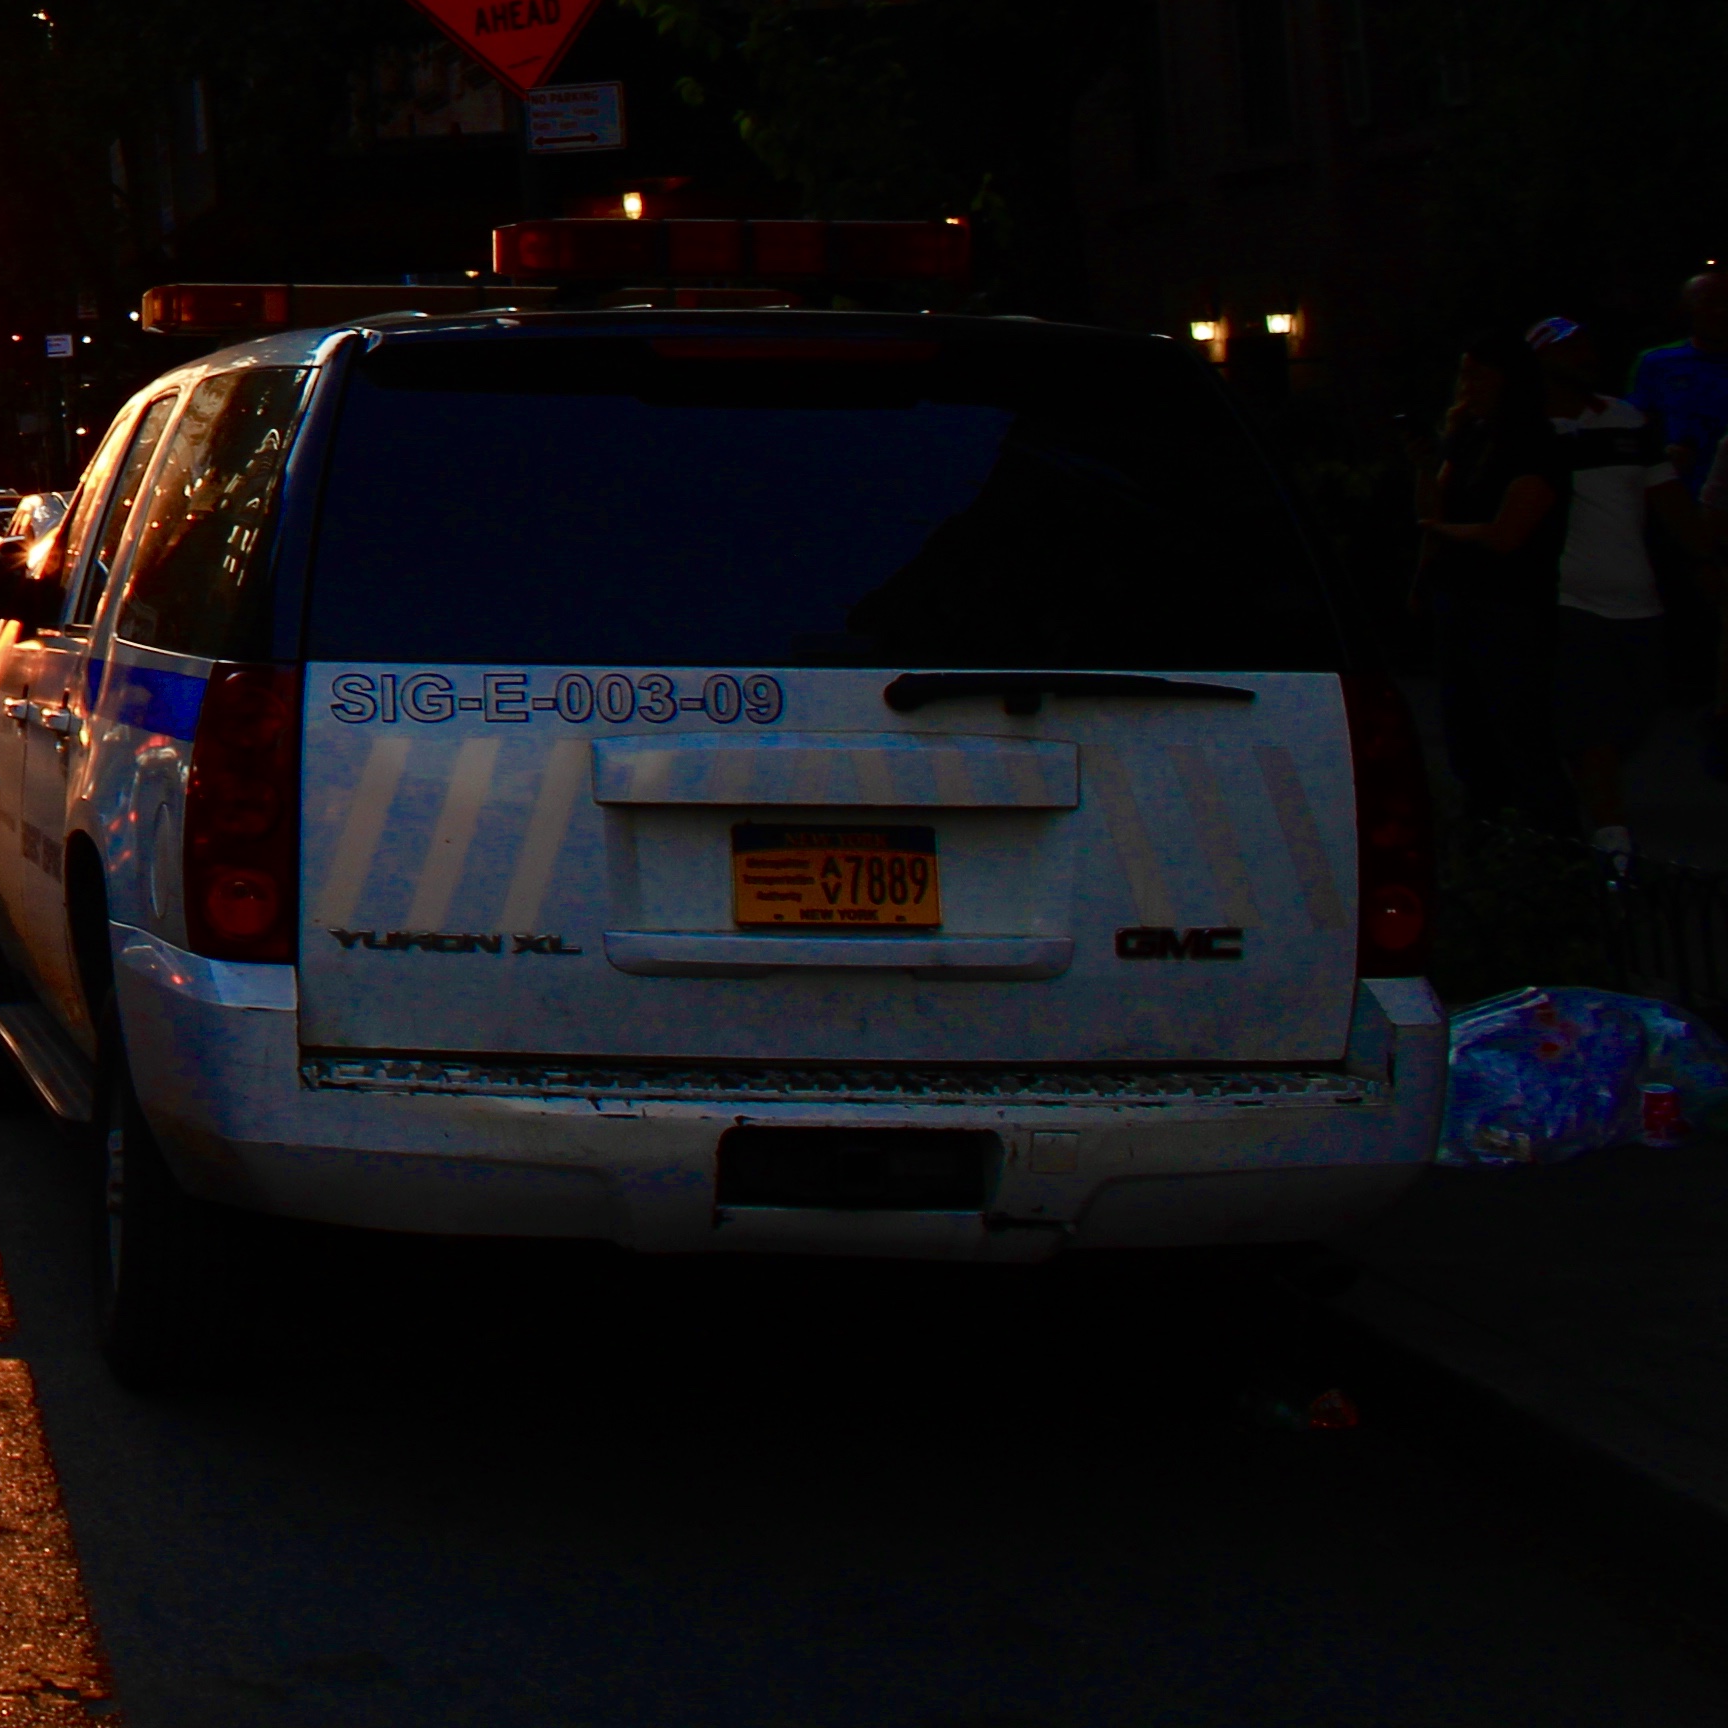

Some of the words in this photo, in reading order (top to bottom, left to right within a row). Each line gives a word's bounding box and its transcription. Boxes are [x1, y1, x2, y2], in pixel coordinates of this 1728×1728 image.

[549, 91, 600, 104] PARKING
[330, 672, 785, 725] SIG-E-003-09
[800, 908, 834, 921] NEW
[837, 908, 878, 921] YORK
[328, 929, 502, 954] YUKON
[512, 934, 583, 955] XL
[1115, 926, 1243, 960] GMC
